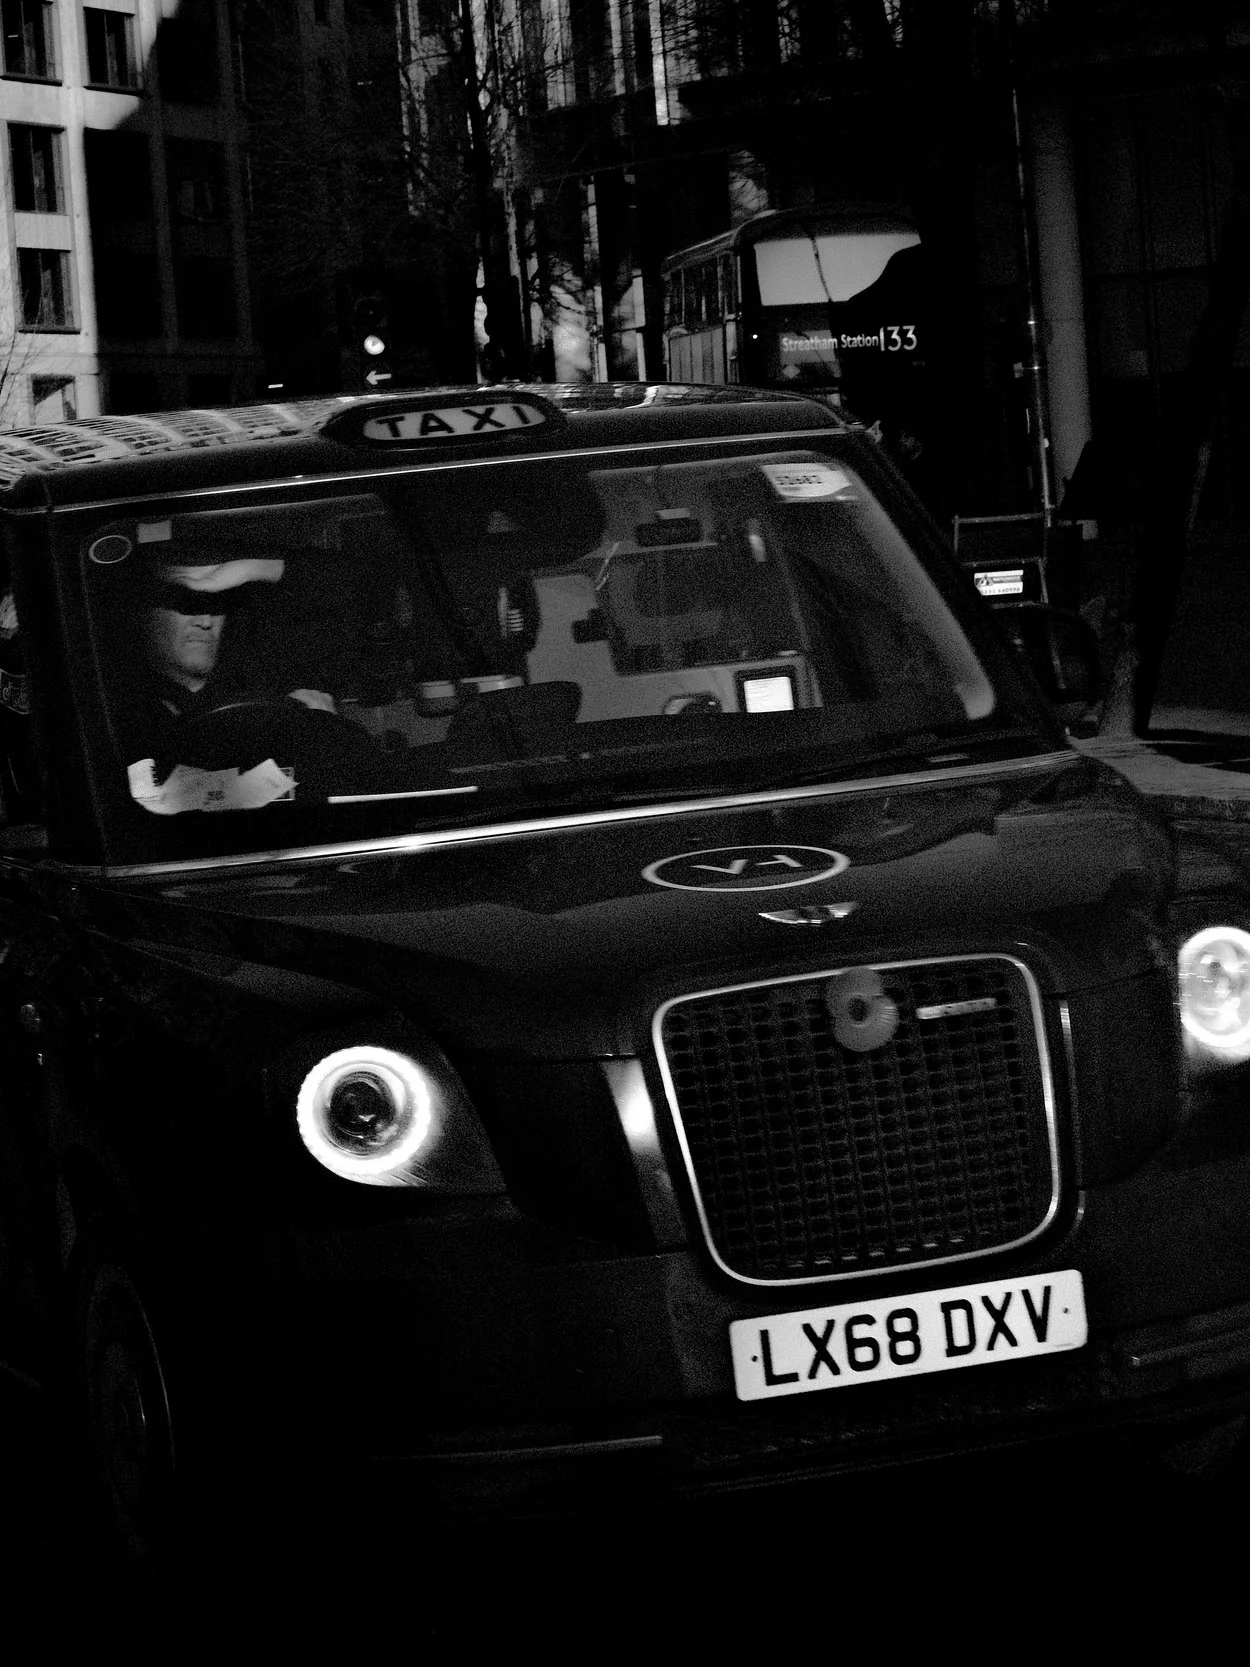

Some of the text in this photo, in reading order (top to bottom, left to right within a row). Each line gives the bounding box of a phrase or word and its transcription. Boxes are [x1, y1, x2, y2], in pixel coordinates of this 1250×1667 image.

[781, 334, 838, 352] Streatham
[841, 333, 879, 349] Station
[377, 405, 532, 438] TAXI
[759, 1285, 1052, 1387] LX68 DXV
